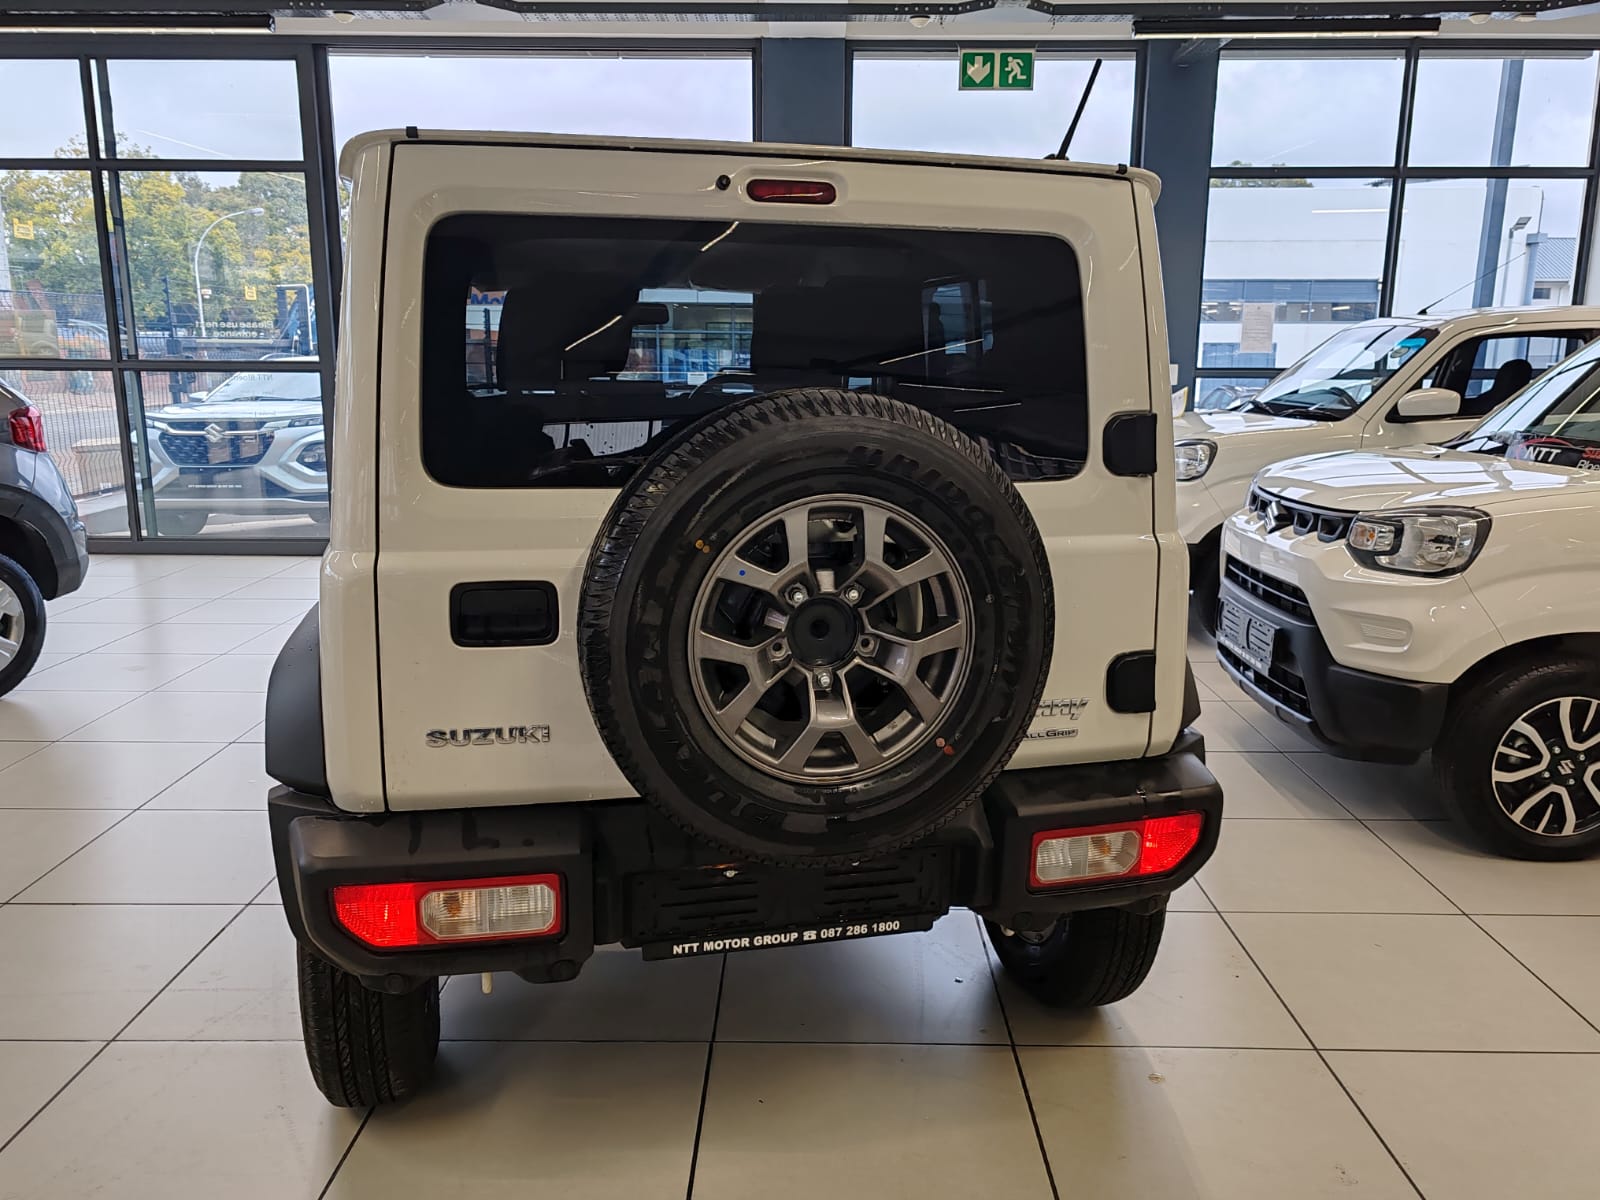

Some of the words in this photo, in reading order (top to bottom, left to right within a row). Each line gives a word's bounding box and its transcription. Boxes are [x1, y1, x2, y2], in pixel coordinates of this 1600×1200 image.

[1523, 446, 1561, 462] NTT
[425, 724, 551, 748] SUZUKI
[672, 942, 700, 955] NTT
[703, 937, 750, 952] MOTOR
[753, 932, 799, 946] GROUP
[820, 928, 843, 939] 087
[846, 924, 868, 936] 286
[871, 920, 900, 933] 1800
